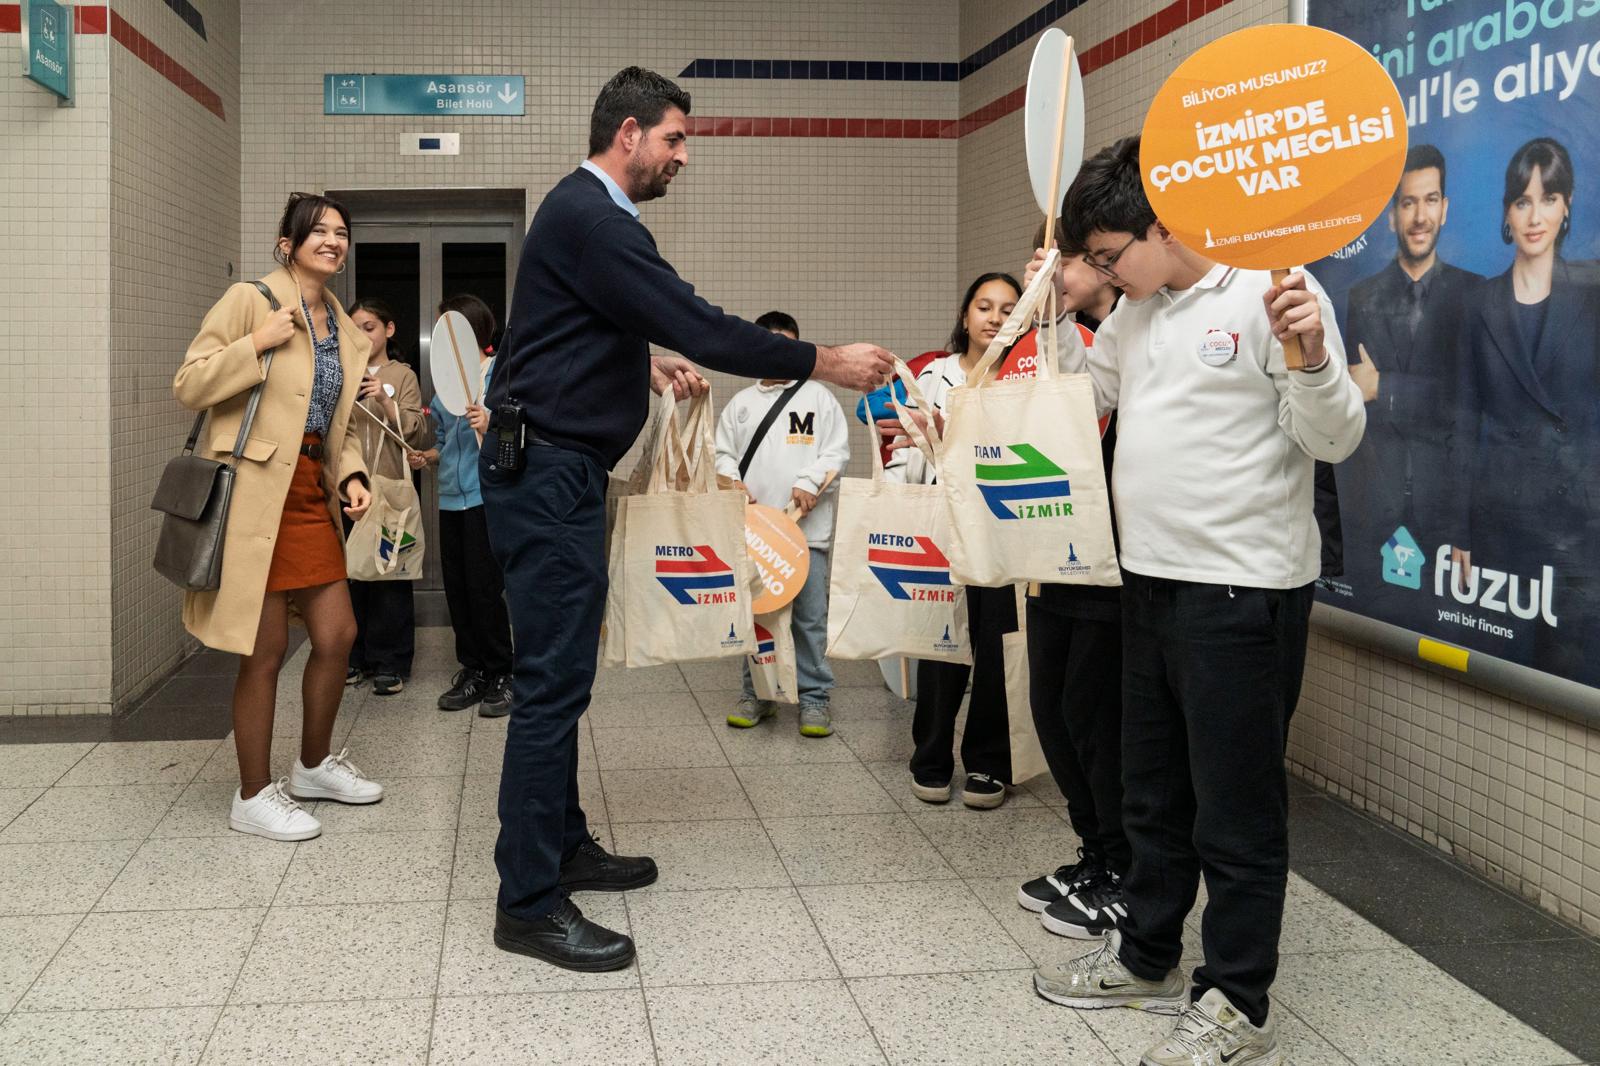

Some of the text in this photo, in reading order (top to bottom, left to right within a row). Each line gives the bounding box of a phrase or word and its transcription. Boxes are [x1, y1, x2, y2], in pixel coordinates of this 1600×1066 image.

[36, 49, 63, 75] Asansör
[426, 81, 493, 94] Asansör
[1182, 59, 1328, 108] BİLİYOR MUSUNUZ?
[436, 99, 493, 109] Bilet Holü
[1195, 99, 1328, 152] İZMİR'DE
[1150, 106, 1395, 193] ÇOCUK MECLİSİ
[1236, 165, 1301, 197] VAR
[1329, 234, 1368, 259] SLİMAT
[789, 411, 815, 435] M
[655, 545, 694, 557] METRO
[868, 533, 914, 548] METRO
[1435, 544, 1558, 628] fuzul
[1438, 609, 1514, 639] yeni bir finans
